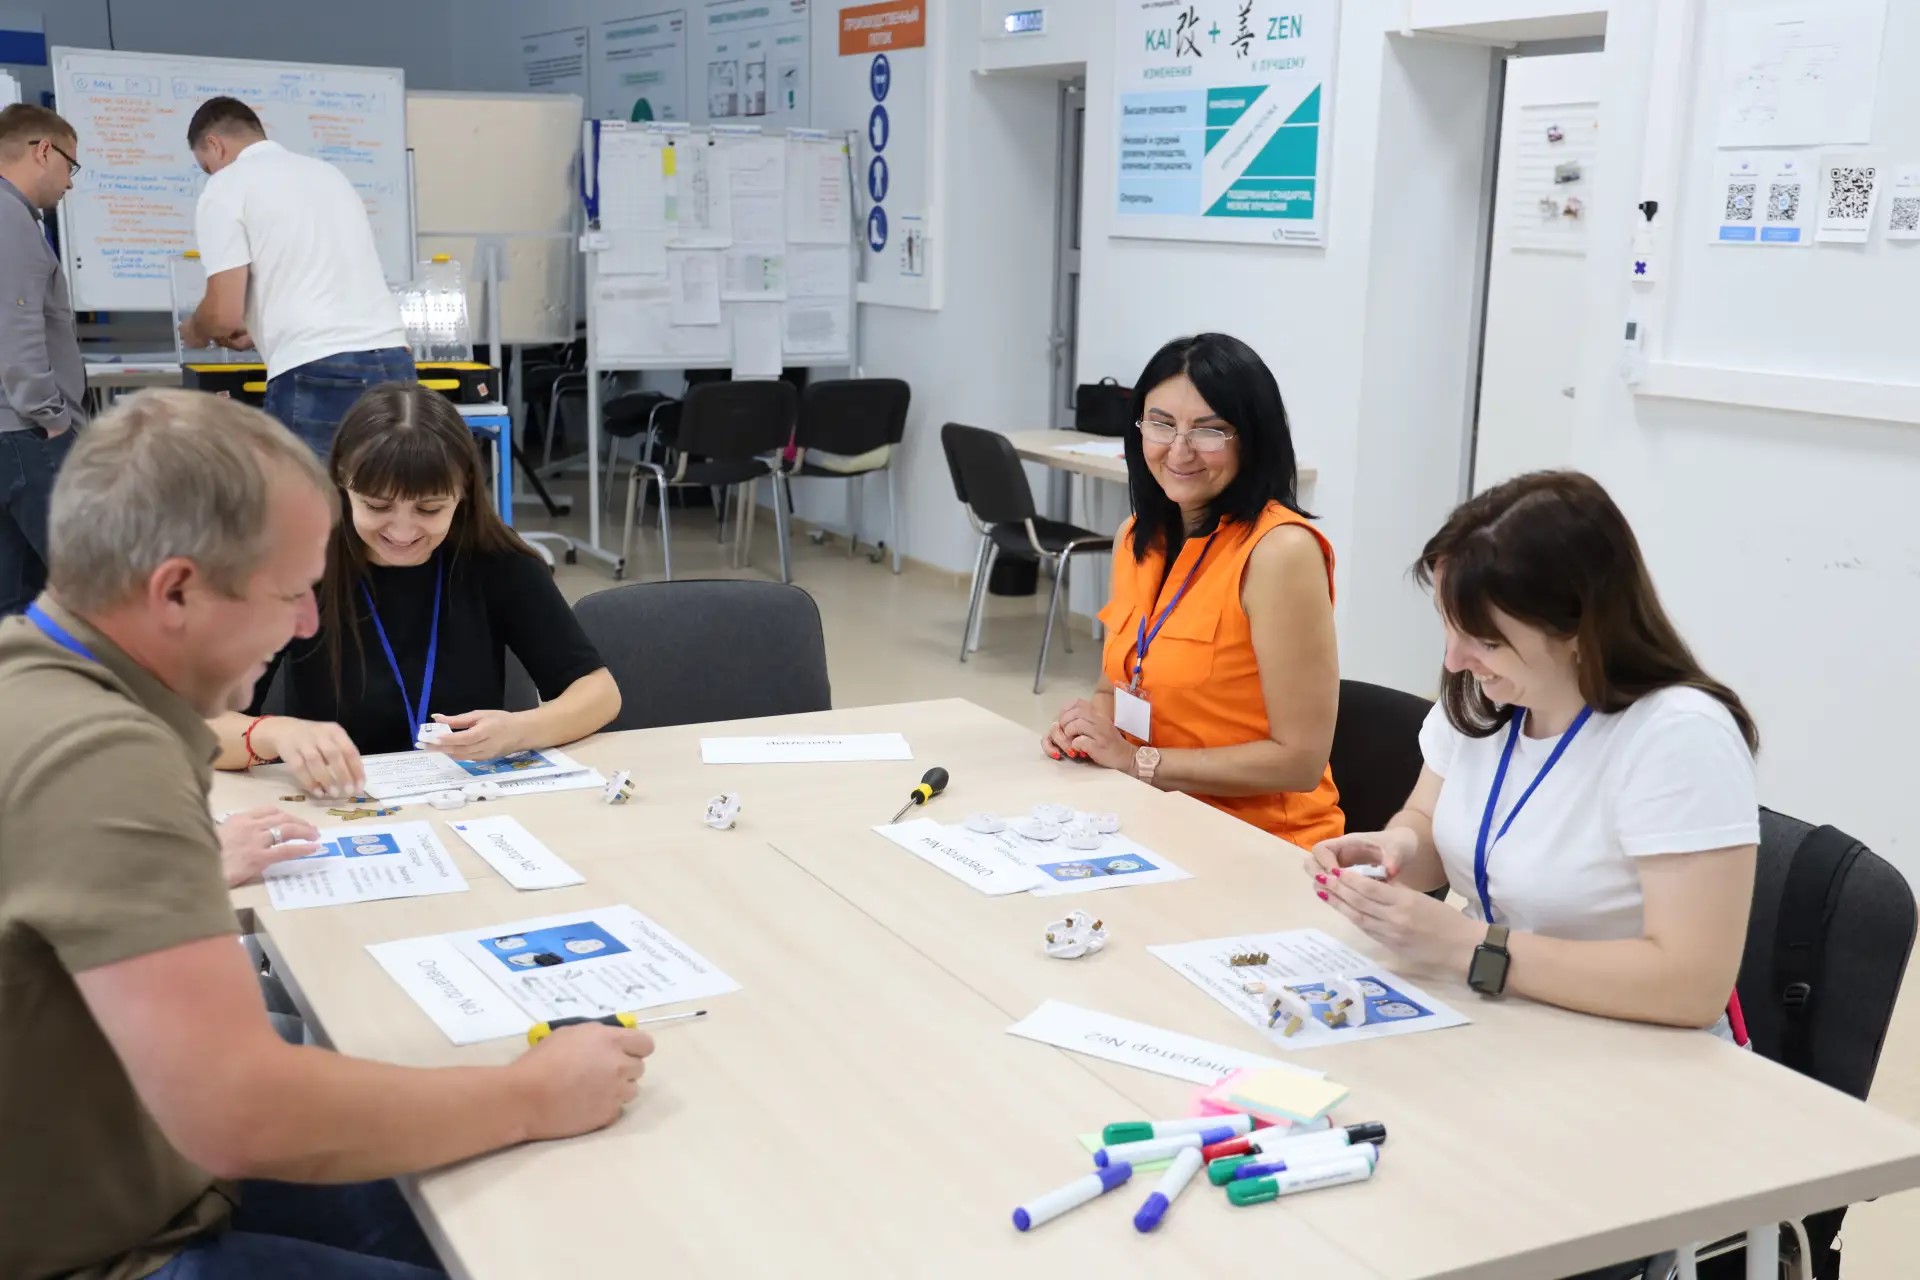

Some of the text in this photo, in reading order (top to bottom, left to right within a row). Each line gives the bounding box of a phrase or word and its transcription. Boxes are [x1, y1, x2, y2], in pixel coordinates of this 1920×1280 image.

[1145, 29, 1172, 51] KAI
[1176, 5, 1202, 57] 改
[1267, 15, 1303, 41] ZEN
[1259, 57, 1306, 71] ЛУЧШЕМУ
[1084, 1031, 1127, 1048] №2
